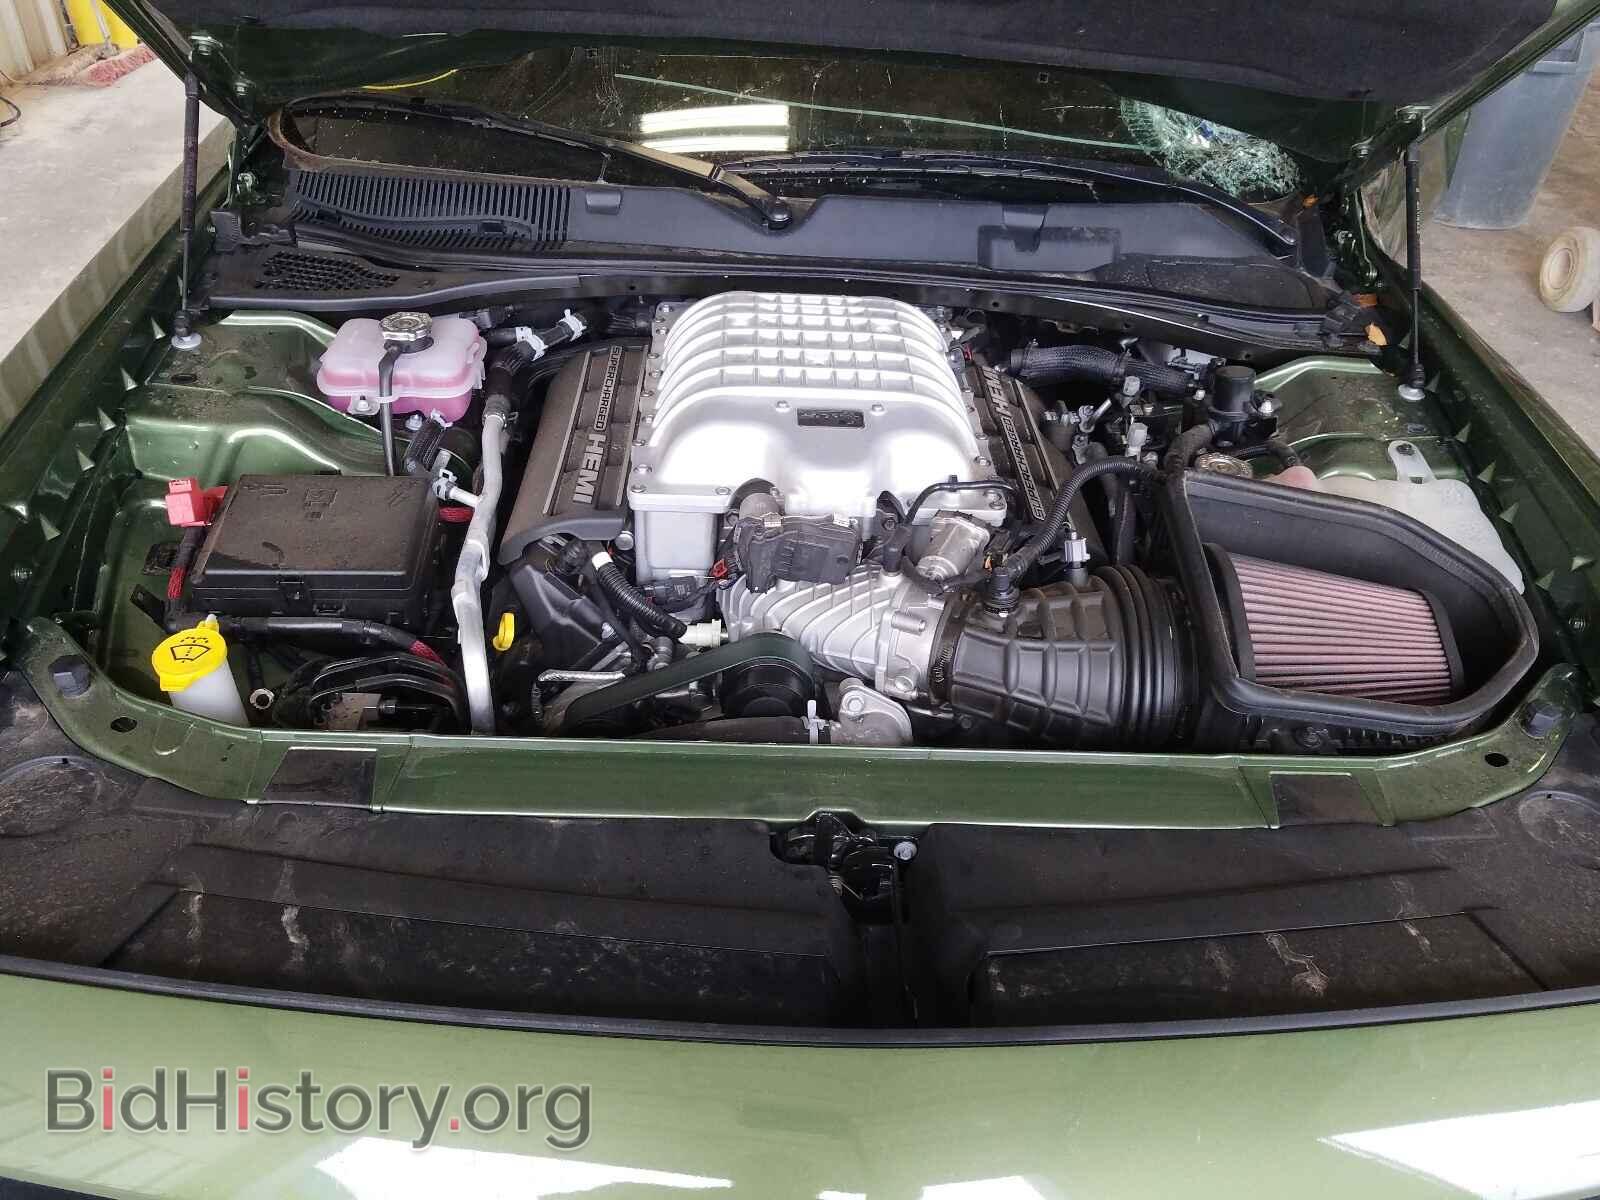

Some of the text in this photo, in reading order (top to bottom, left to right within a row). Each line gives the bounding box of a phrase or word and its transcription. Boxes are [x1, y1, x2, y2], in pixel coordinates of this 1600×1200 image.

[573, 346, 622, 504] SUPERCHARGED HEMI
[1001, 417, 1047, 520] SUPERCHARGED
